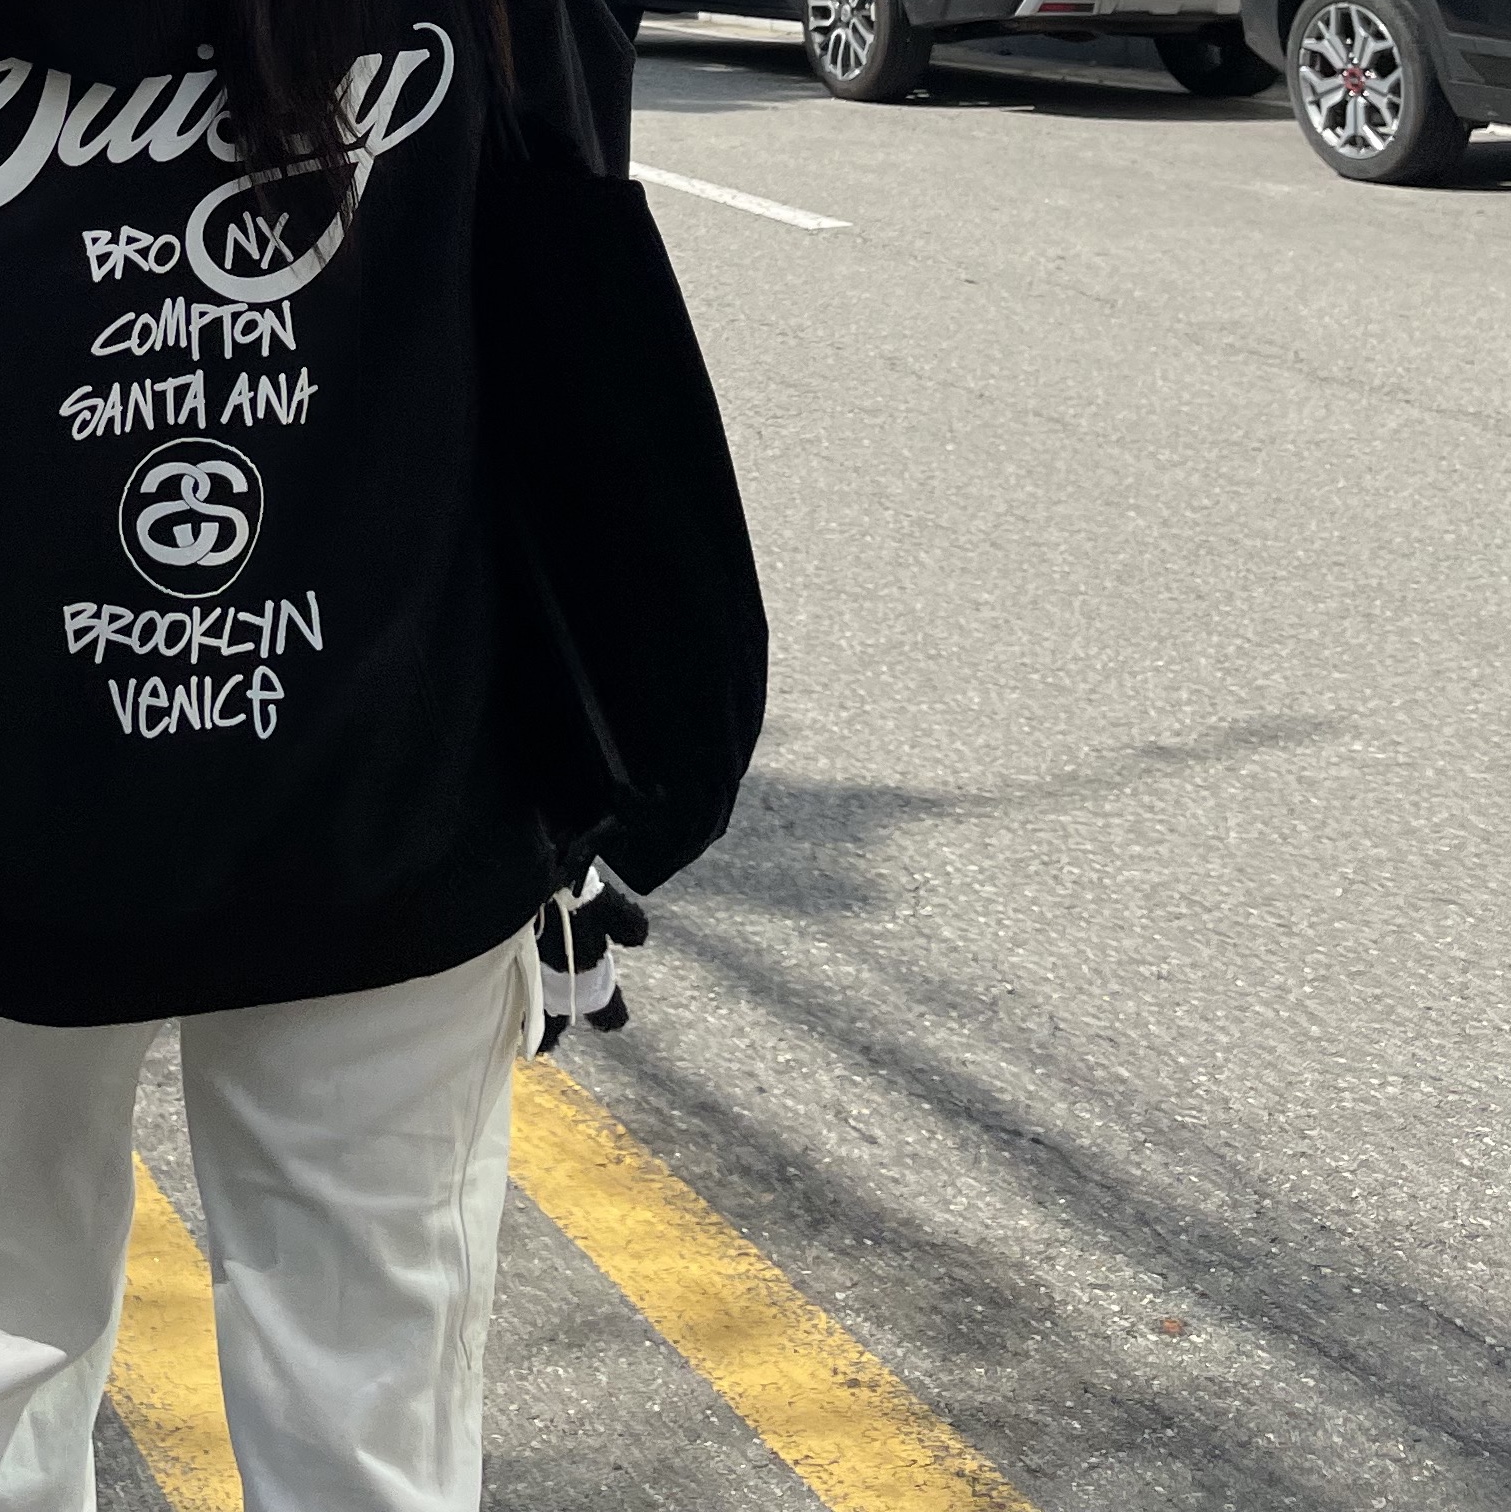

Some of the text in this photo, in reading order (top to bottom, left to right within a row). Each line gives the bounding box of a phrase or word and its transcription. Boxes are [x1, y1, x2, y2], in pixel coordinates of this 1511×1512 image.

[91, 296, 297, 358] COMPTON
[59, 366, 319, 441] SANTA ANA
[63, 590, 324, 665] BROOKLYN
